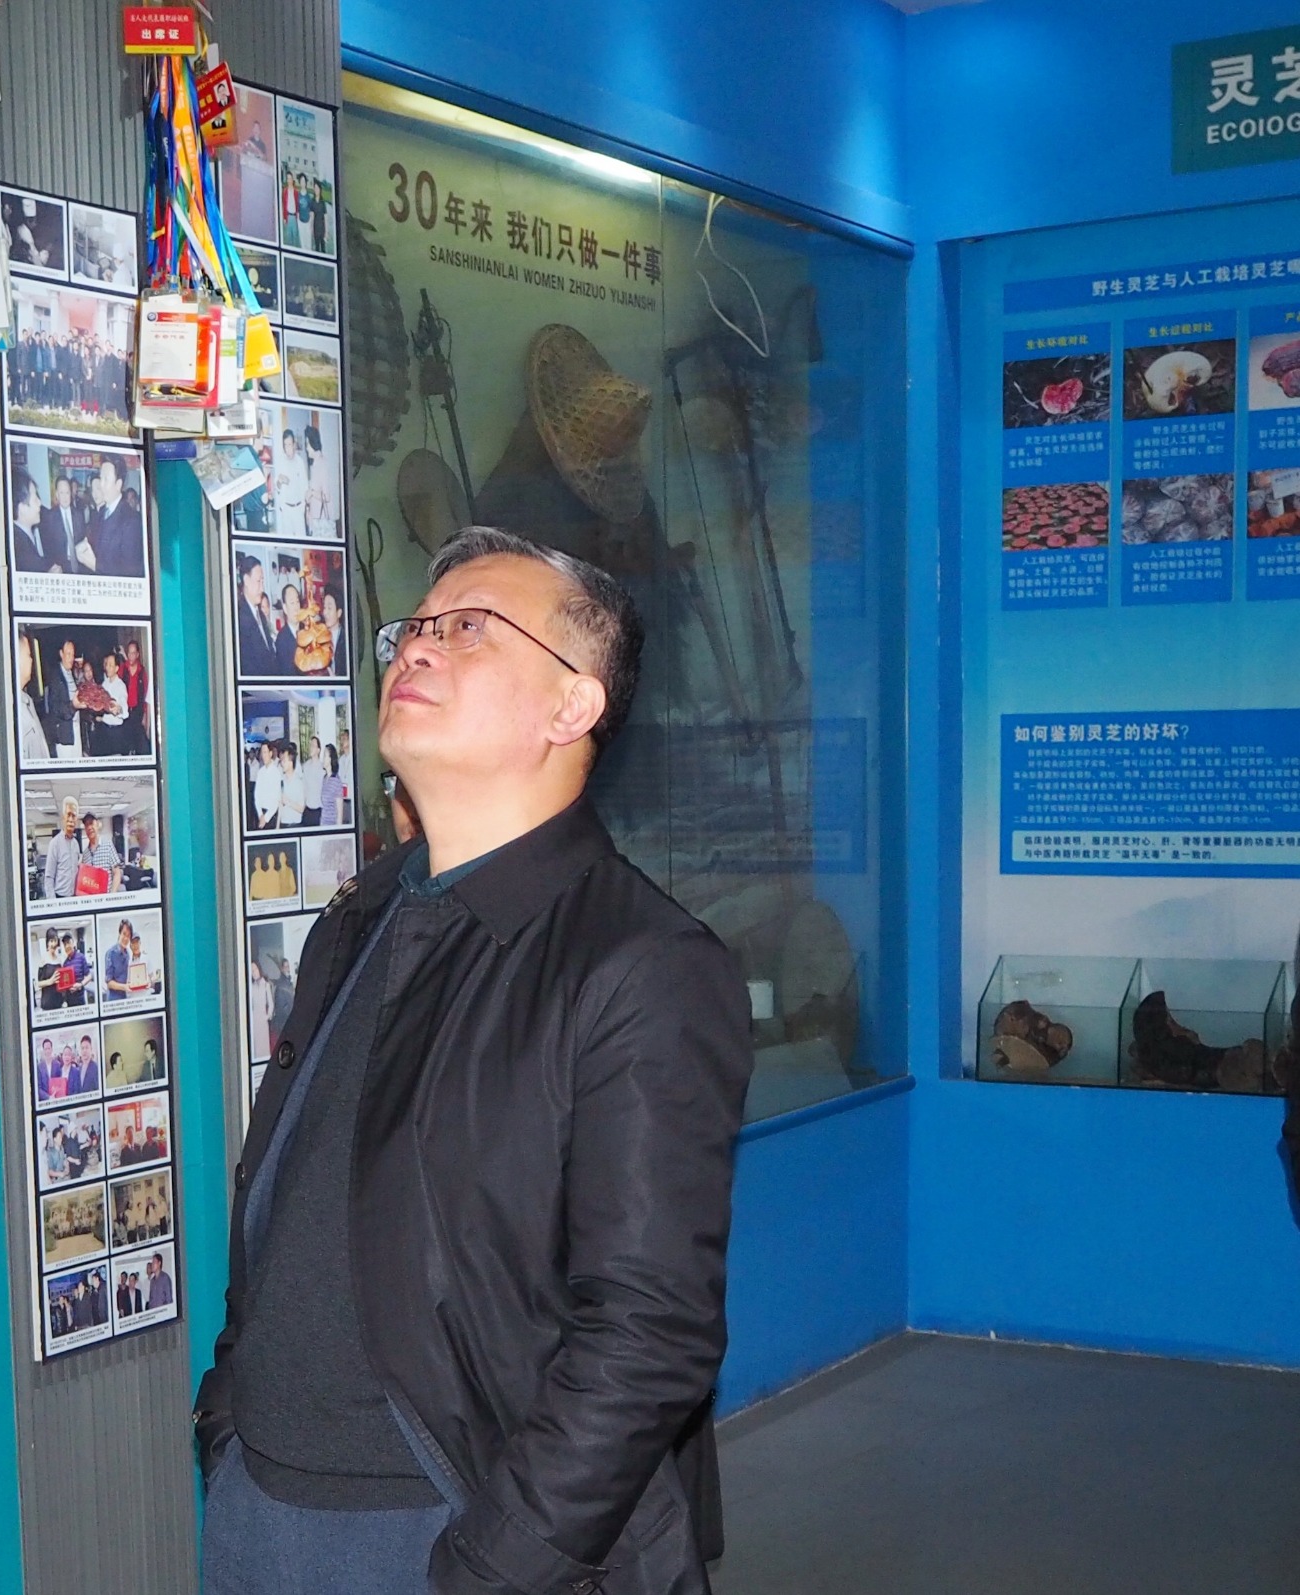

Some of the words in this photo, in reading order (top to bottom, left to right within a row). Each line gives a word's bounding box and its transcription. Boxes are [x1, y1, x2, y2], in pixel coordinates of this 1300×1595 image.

[388, 162, 493, 243] 30年来
[506, 211, 663, 286] 我们只做一件事
[430, 245, 519, 281] SANSHINIANLAI
[524, 268, 565, 292] WOMEN
[569, 278, 606, 301] ZHIZUO
[610, 288, 656, 313] YIJIANSHI
